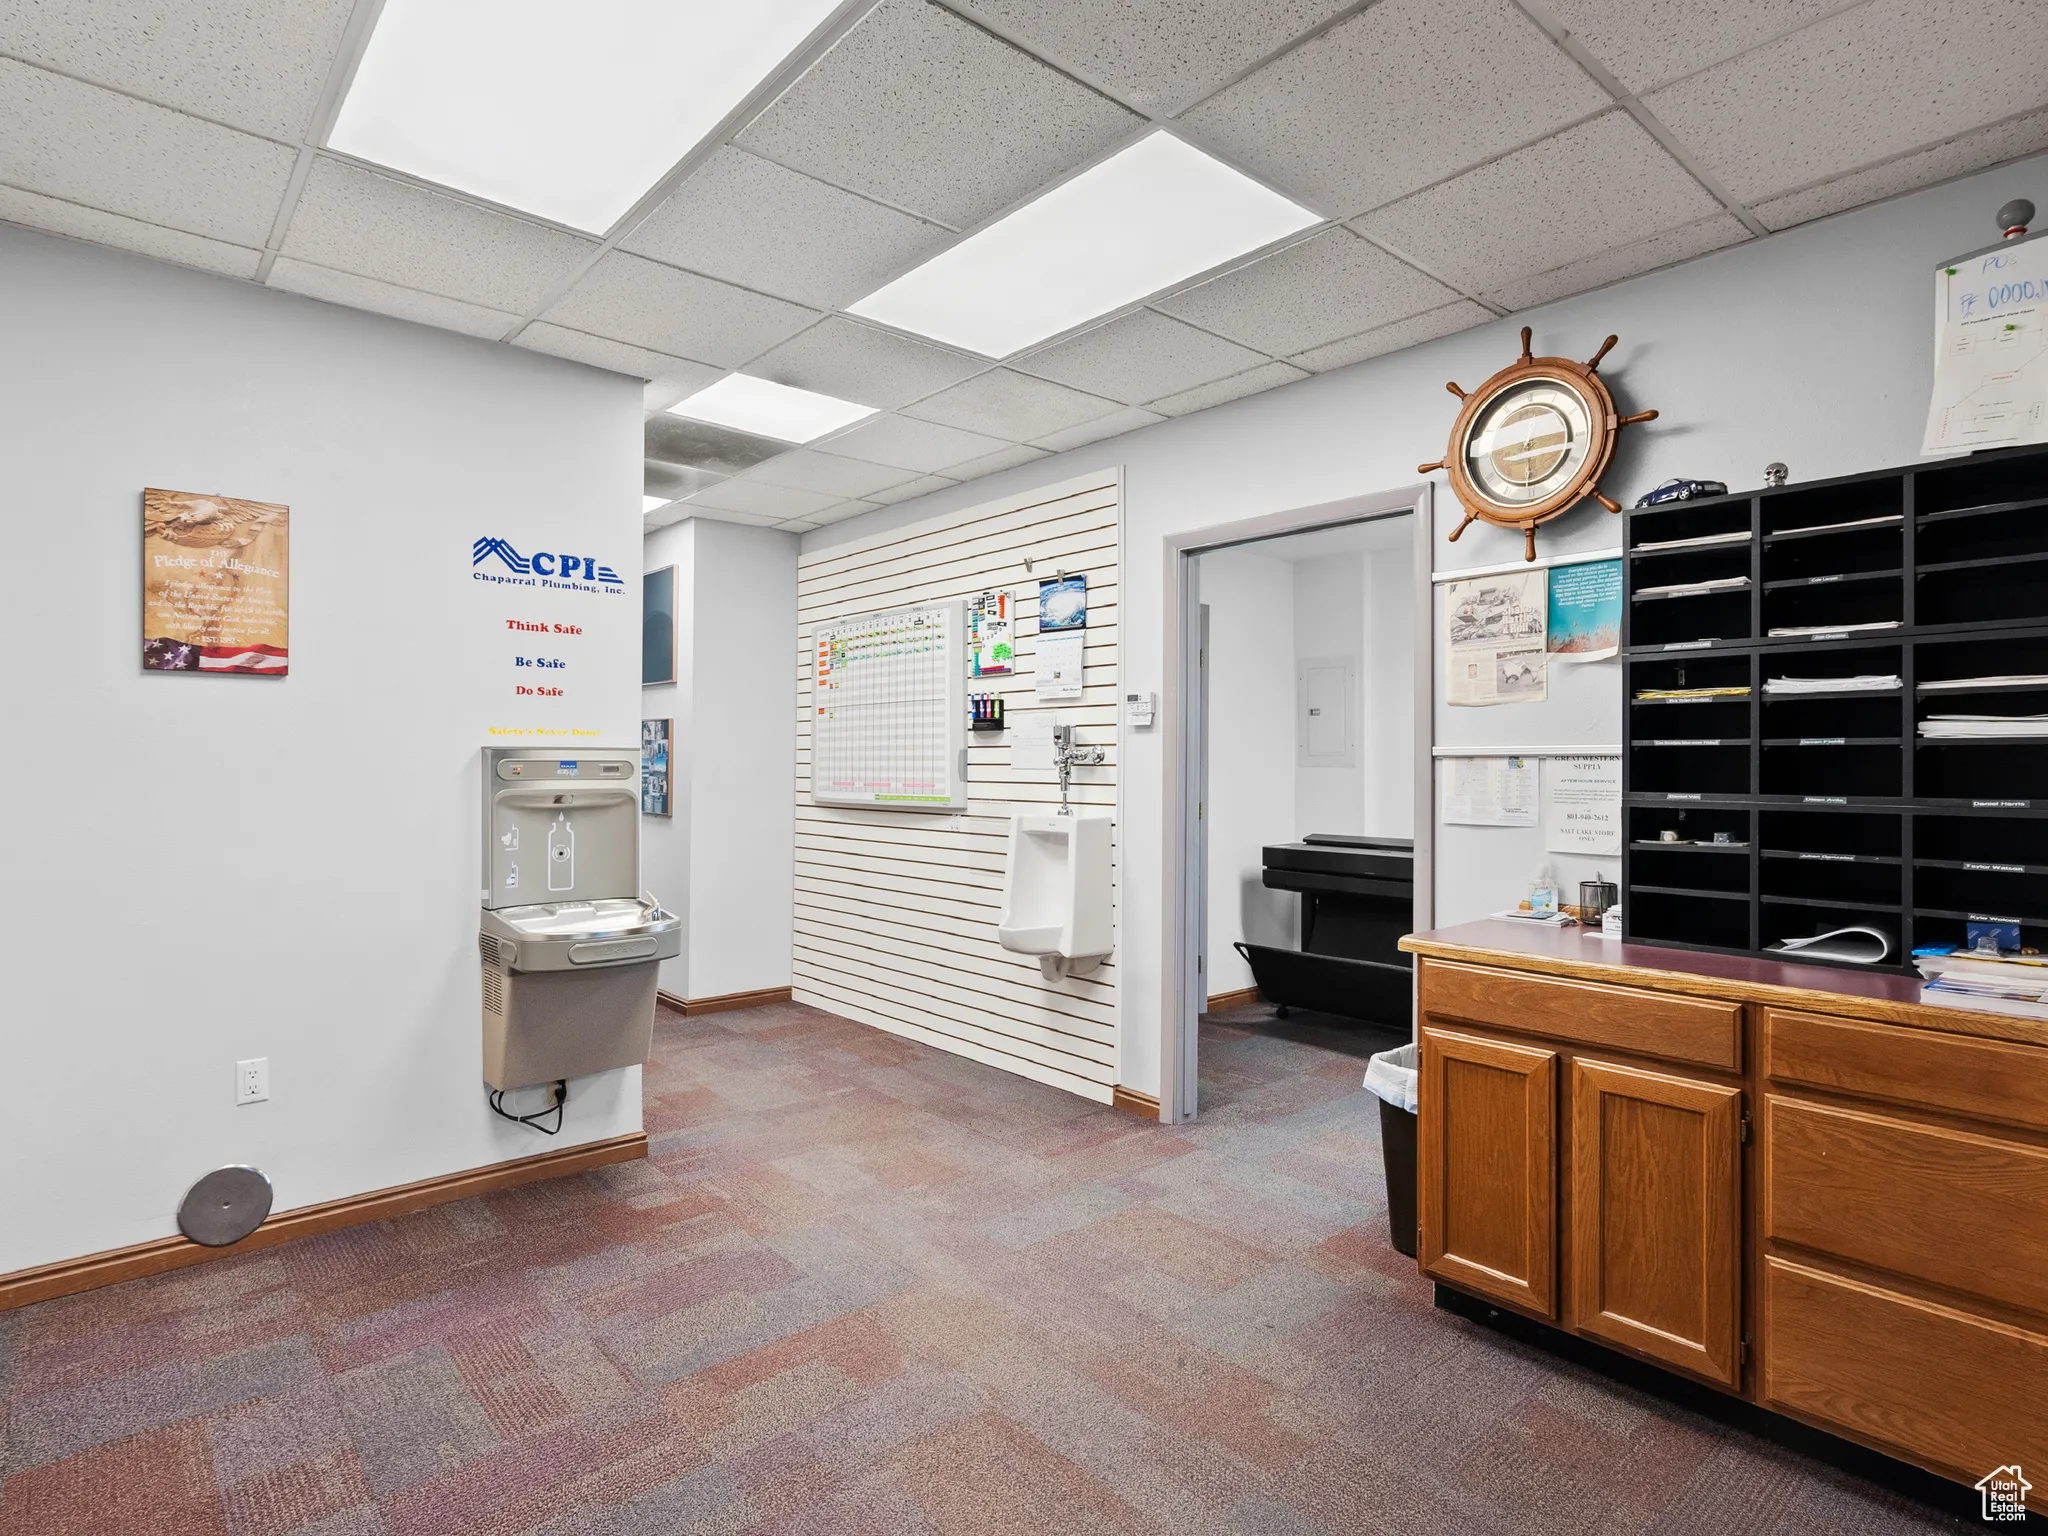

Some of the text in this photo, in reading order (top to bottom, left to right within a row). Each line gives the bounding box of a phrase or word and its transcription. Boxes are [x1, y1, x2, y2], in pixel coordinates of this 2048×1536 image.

[154, 555, 280, 577] Pledge of Allegiance
[531, 552, 596, 581] CPI
[473, 572, 626, 595] Chaparral Plumbing, Inc.
[1502, 612, 1533, 623] Rattle
[506, 620, 583, 635] Think Safe
[515, 656, 566, 669] Be Safe
[516, 685, 564, 697] Do Safe
[489, 727, 532, 737] Safety's
[536, 728, 568, 736] Never
[1594, 829, 1616, 837] STORE
